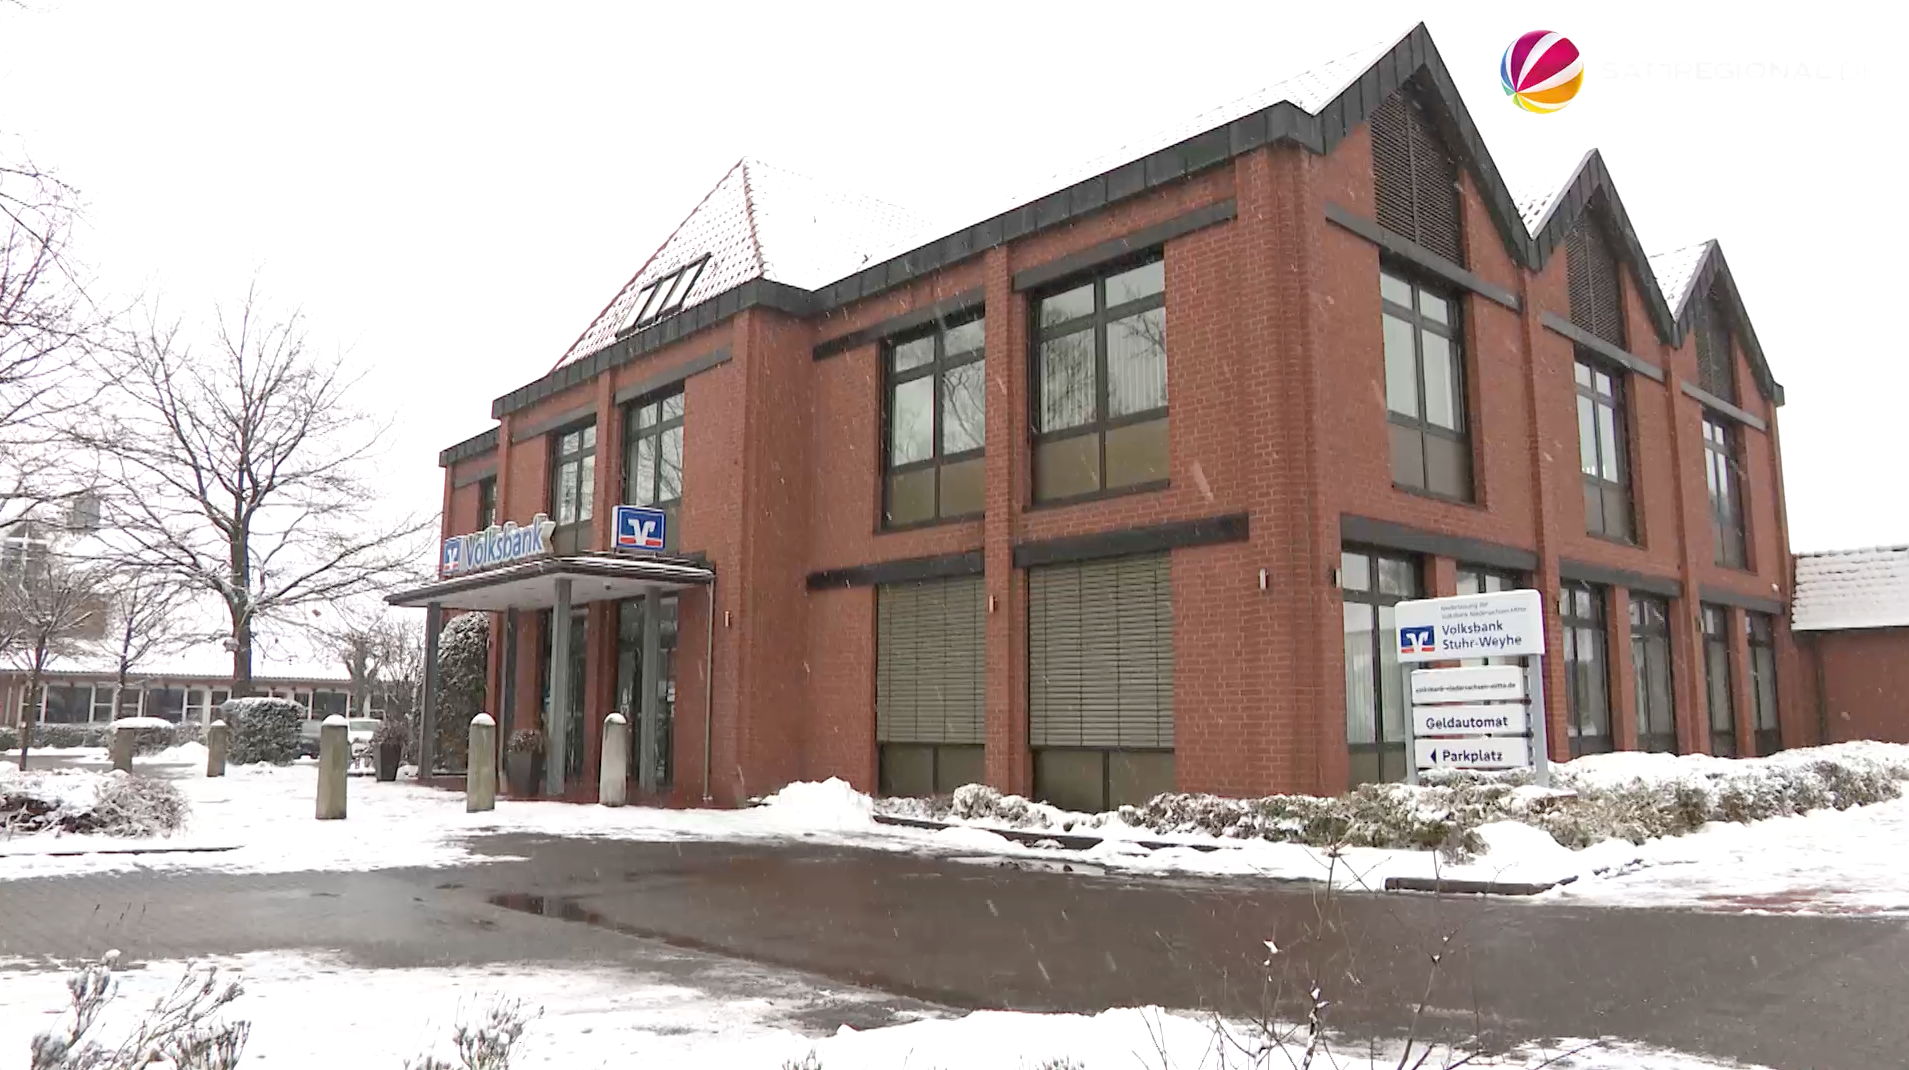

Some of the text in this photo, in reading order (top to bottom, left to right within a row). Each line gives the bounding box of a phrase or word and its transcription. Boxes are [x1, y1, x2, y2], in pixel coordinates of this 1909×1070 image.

[465, 523, 542, 568] Volksbank
[1441, 620, 1503, 636] Volksbank
[1442, 635, 1522, 650] Stuhr-Weyhe
[1425, 715, 1509, 730] Geldautomat
[1442, 749, 1503, 766] Parkplatz
